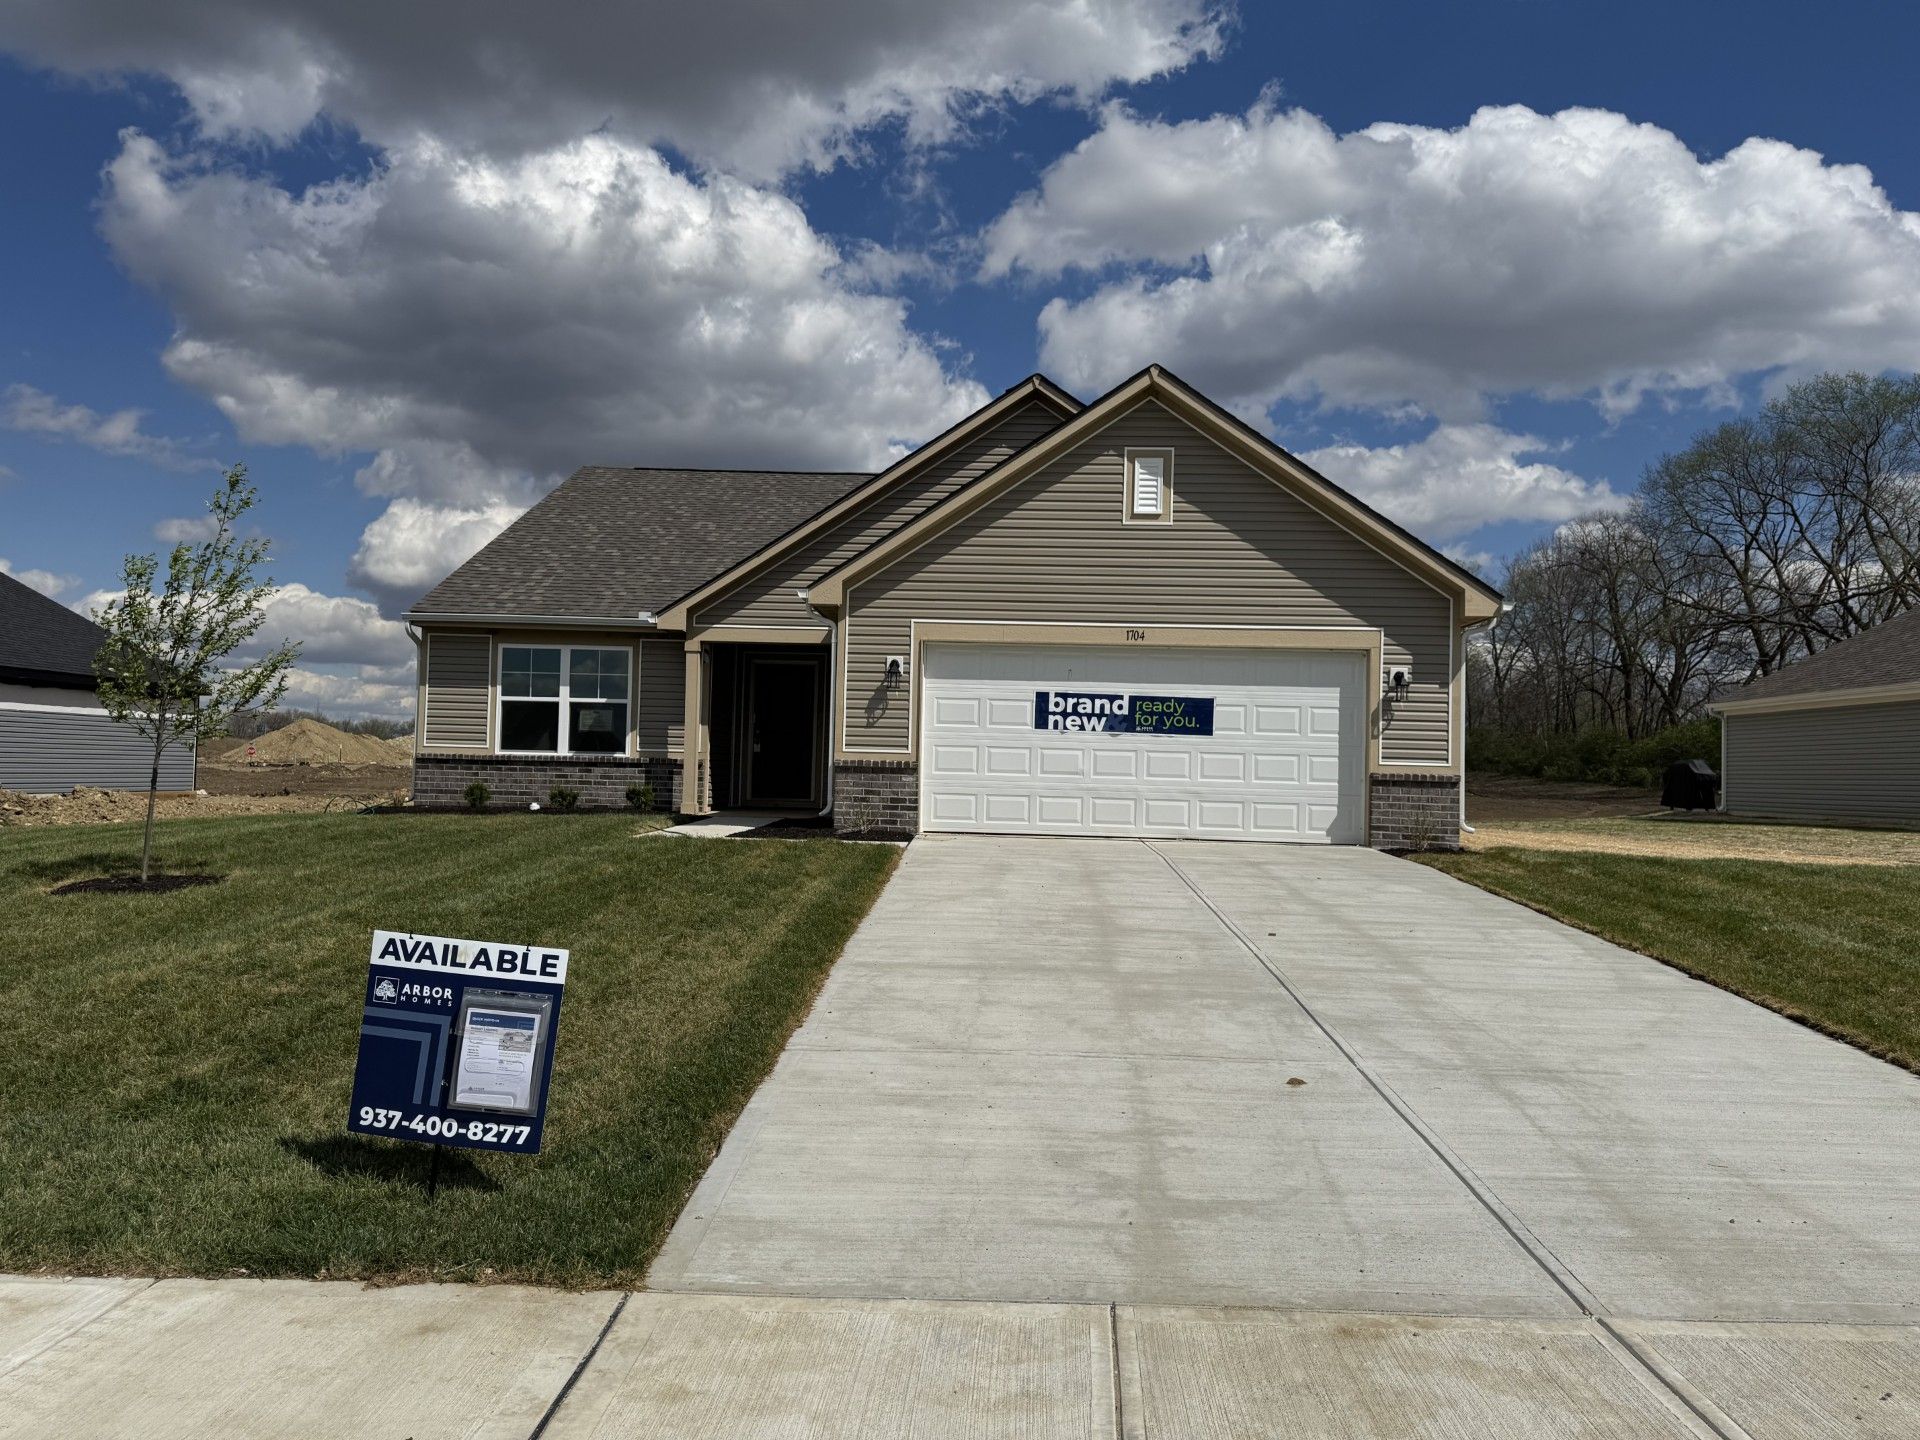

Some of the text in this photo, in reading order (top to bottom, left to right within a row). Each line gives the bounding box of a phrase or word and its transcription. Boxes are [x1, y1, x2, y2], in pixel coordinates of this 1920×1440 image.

[1126, 630, 1145, 641] 1704
[1048, 692, 1130, 715] brand
[1136, 698, 1185, 716] ready
[1047, 714, 1107, 732] new
[1135, 711, 1200, 729] for you.
[378, 937, 560, 978] AVAILABLE
[401, 983, 453, 999] ARBOR
[400, 995, 453, 1006] HOMES
[359, 1106, 531, 1145] 937-400-8277
